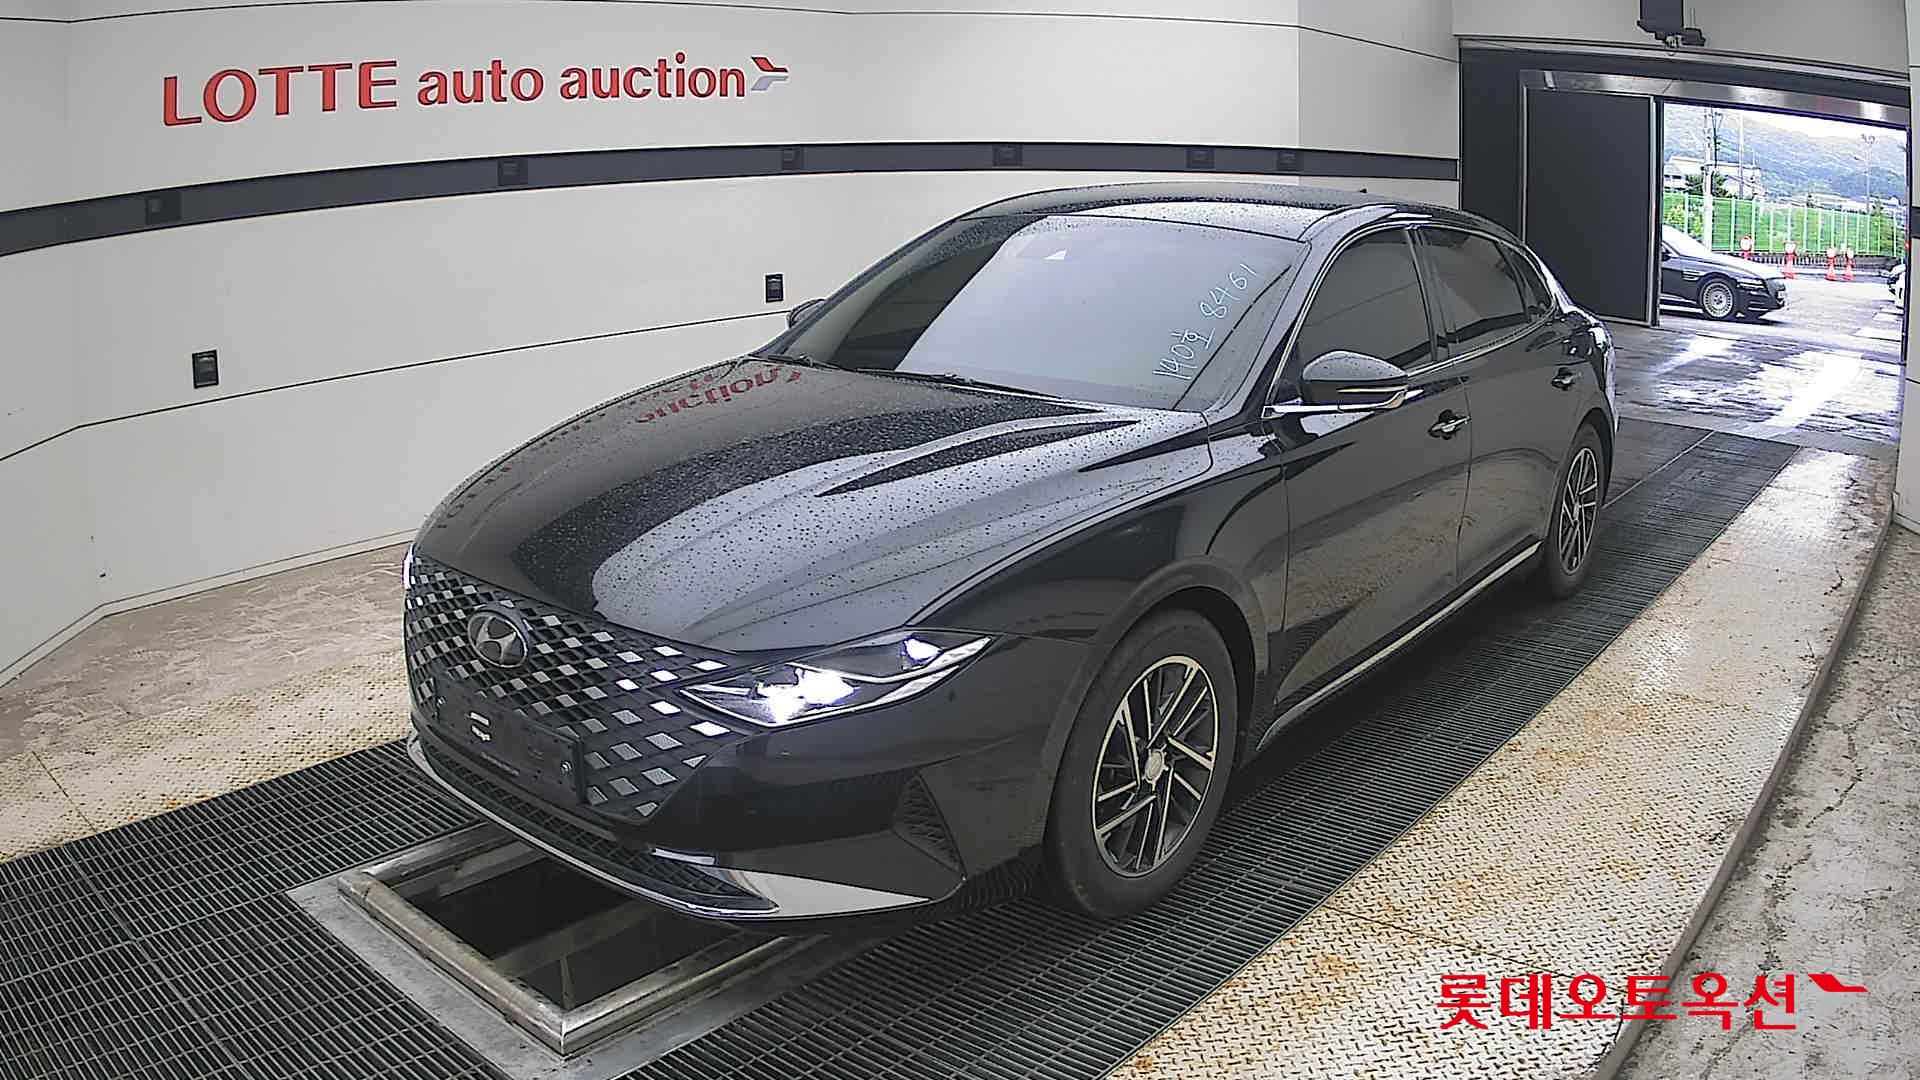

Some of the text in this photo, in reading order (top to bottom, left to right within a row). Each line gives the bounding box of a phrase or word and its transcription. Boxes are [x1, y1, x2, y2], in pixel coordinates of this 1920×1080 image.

[164, 52, 745, 127] LOTTE auto auction
[1200, 263, 1257, 319] 8461
